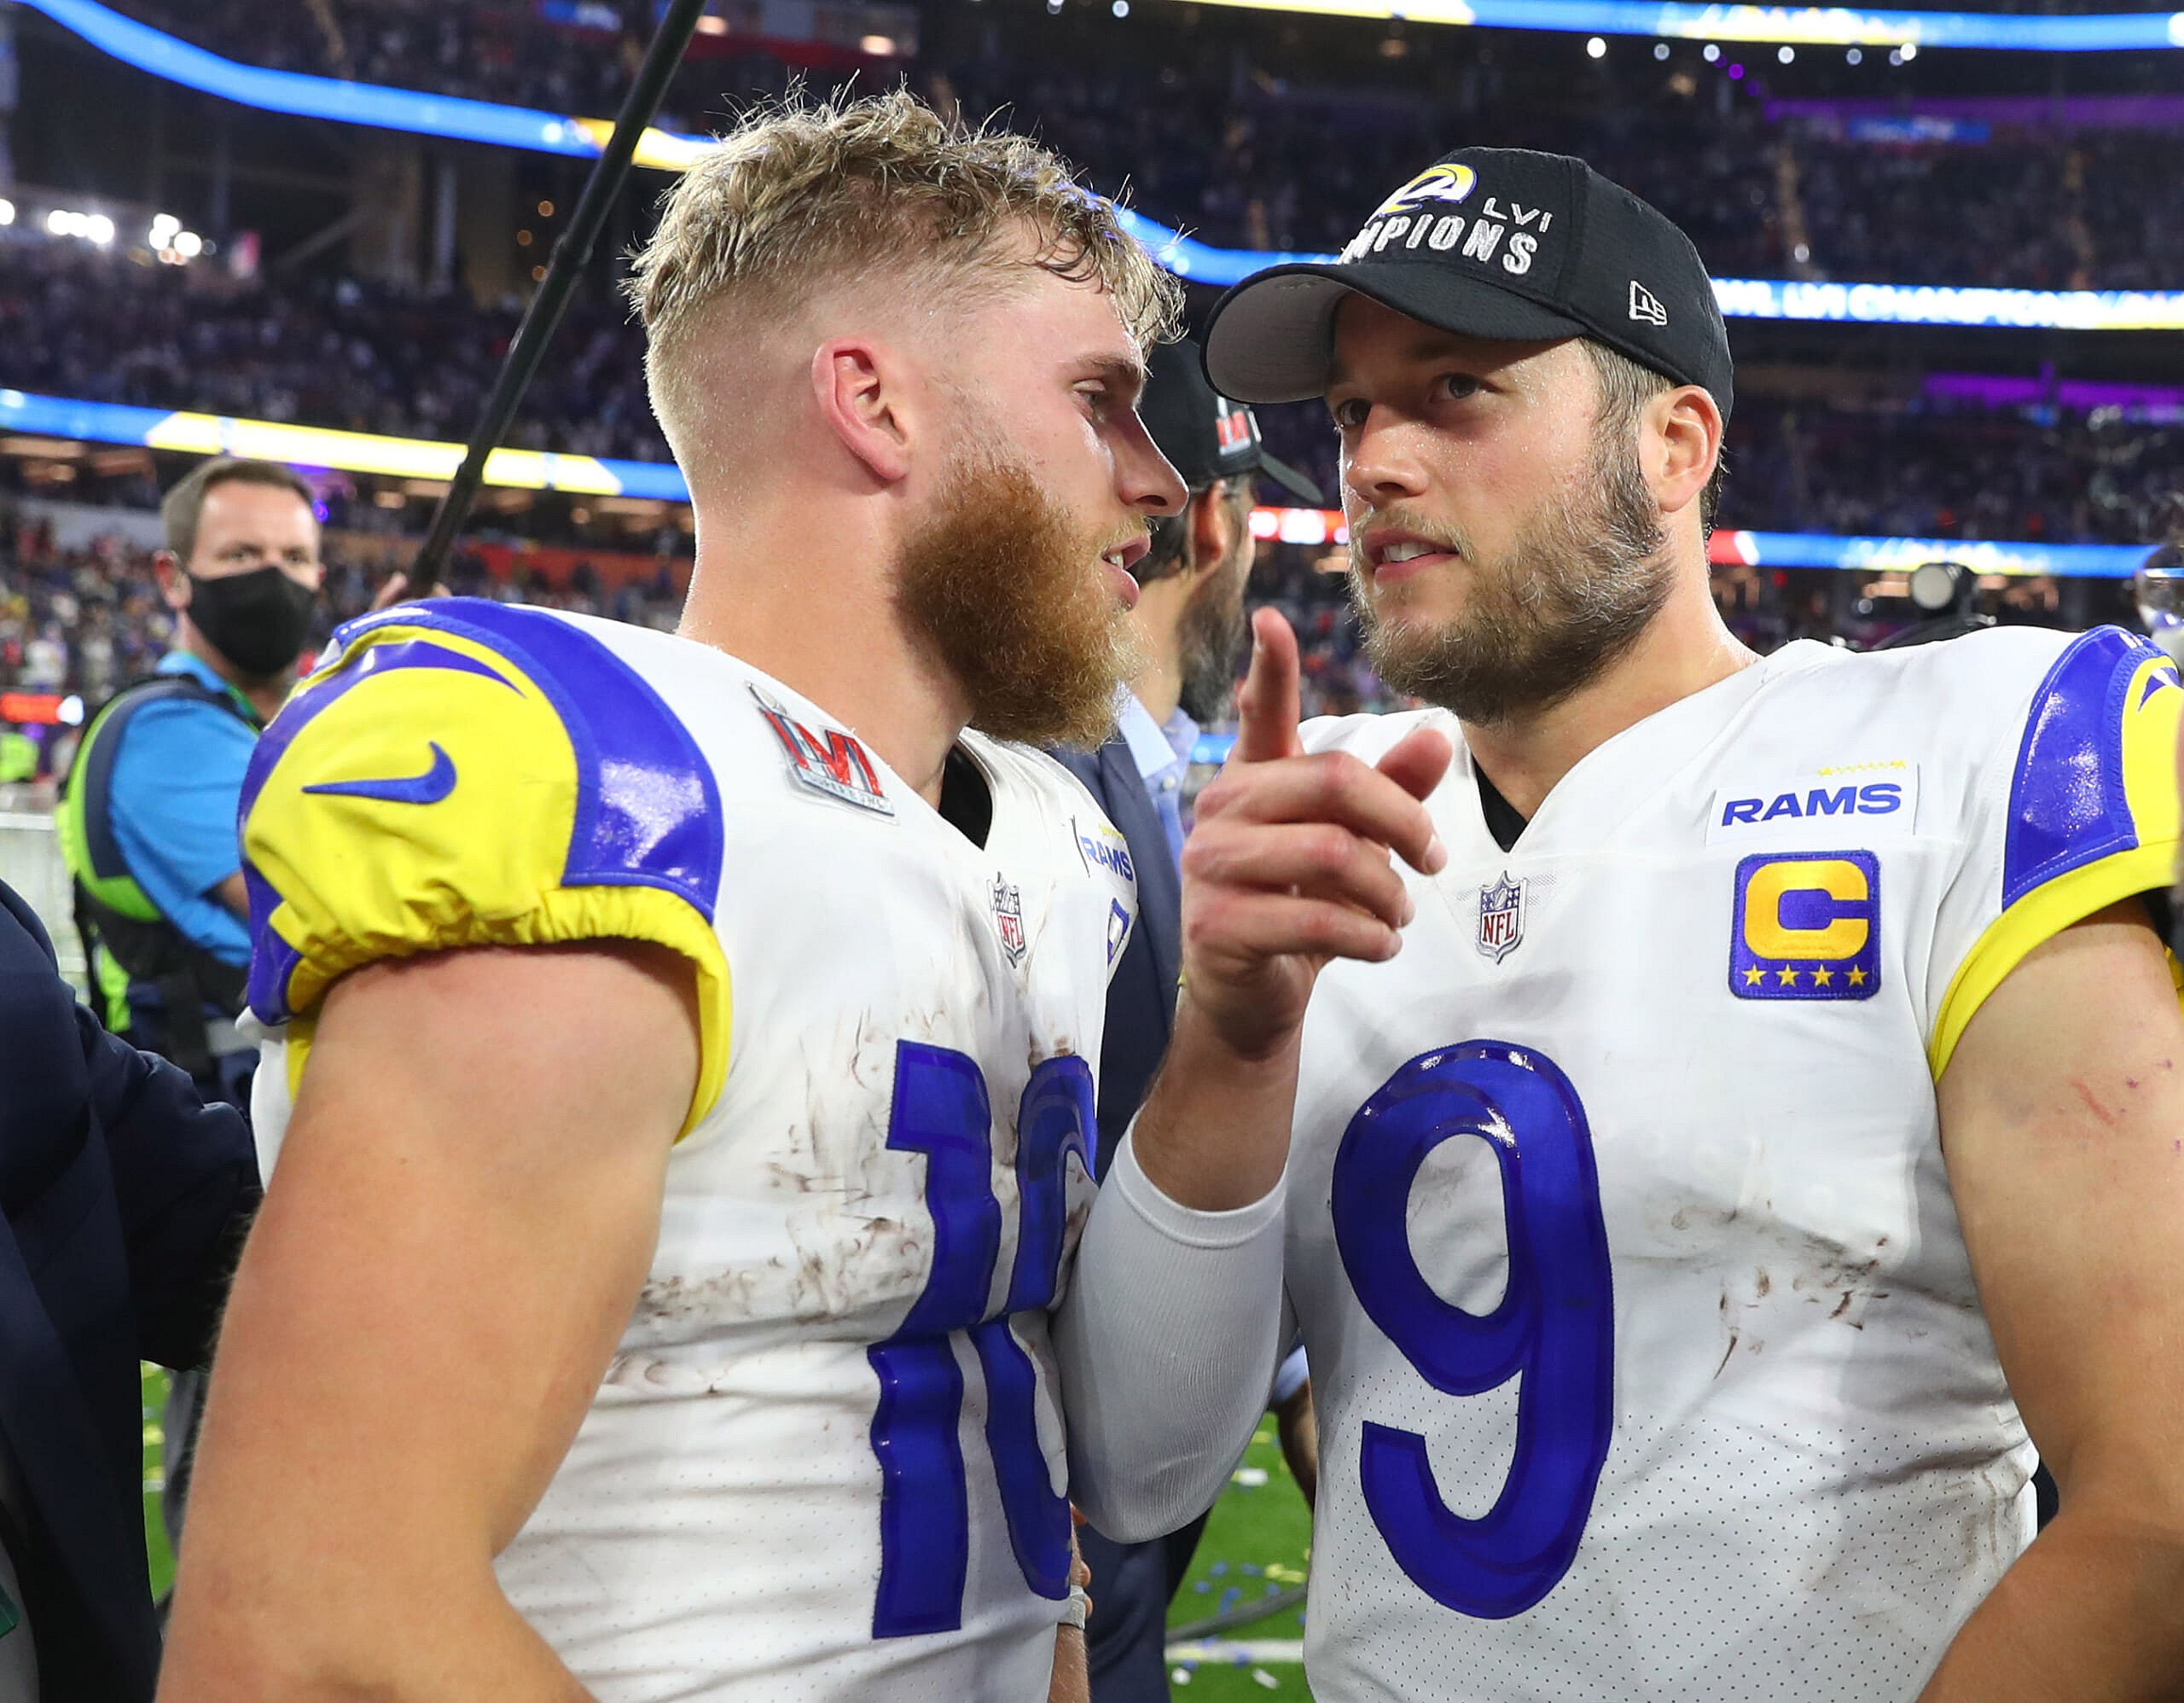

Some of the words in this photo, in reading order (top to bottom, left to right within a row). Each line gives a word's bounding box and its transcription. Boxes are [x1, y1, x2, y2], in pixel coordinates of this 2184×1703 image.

[1483, 197, 1553, 232] LVI
[1722, 782, 1902, 827] RAMS
[1079, 835, 1134, 882] RAMS
[998, 915, 1023, 950] NFL
[1482, 911, 1515, 946] NFL
[1744, 859, 1869, 960] C
[867, 1038, 1099, 1638] 10
[1331, 1038, 1614, 1619] 9
